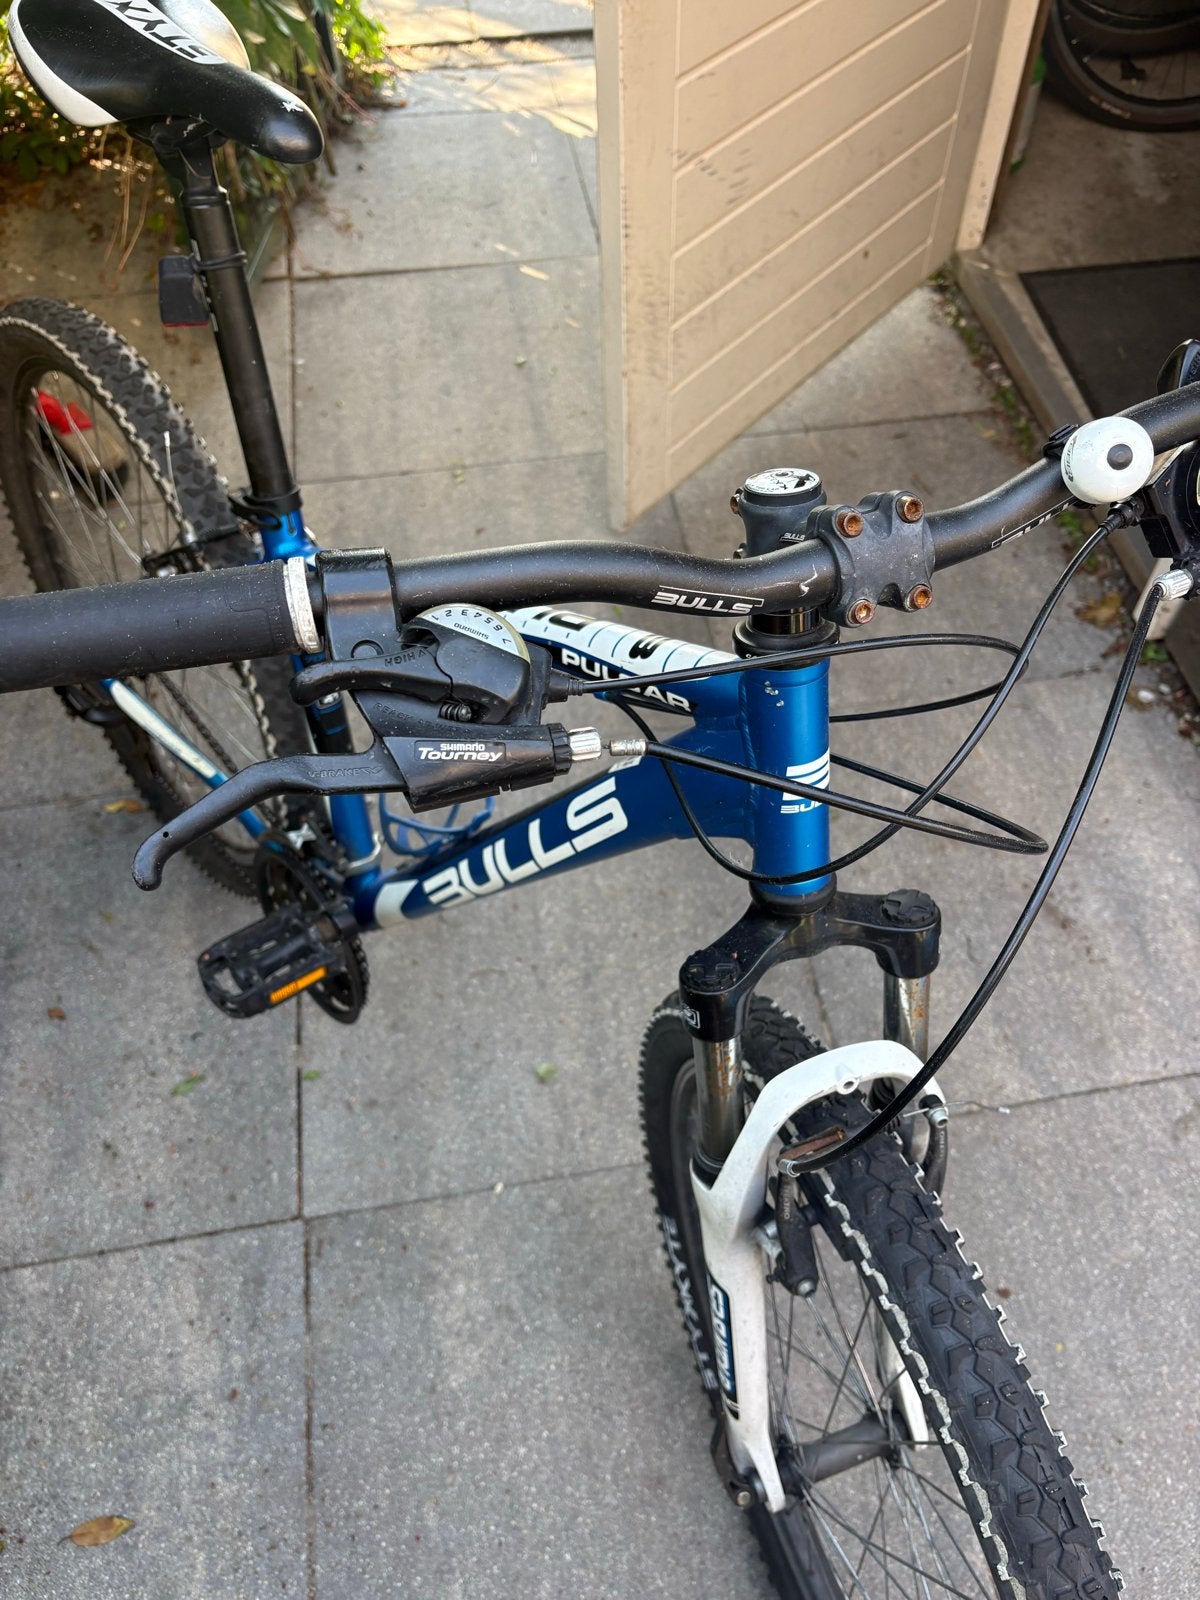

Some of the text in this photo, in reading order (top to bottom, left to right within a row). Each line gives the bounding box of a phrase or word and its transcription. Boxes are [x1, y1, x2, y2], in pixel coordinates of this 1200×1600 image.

[783, 532, 806, 541] BULLS
[651, 591, 754, 614] BULLS
[560, 647, 692, 713] PULAR
[418, 747, 503, 762] Tourney
[440, 743, 486, 751] SHIMANO
[421, 775, 629, 908] BULLS
